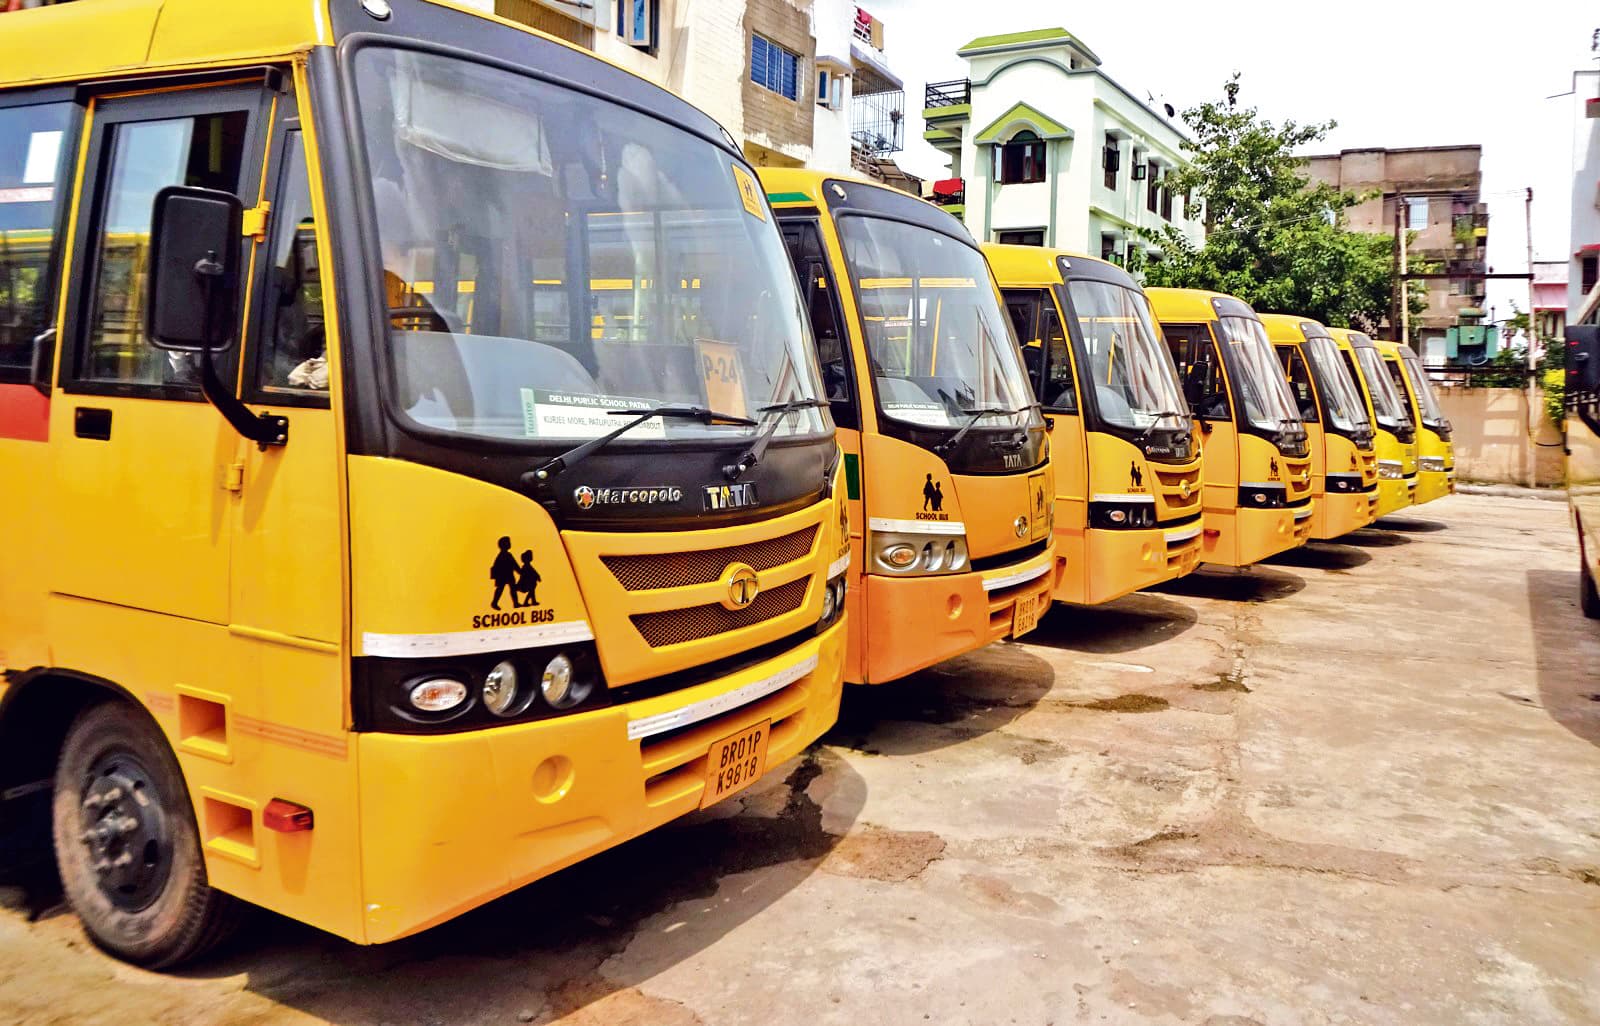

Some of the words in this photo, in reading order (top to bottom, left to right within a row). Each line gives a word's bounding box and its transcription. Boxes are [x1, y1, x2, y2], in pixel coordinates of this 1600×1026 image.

[703, 355, 738, 384] P-24
[549, 395, 572, 403] DELHI
[573, 397, 599, 406] PUBLIC
[600, 398, 628, 408] SCHOOL
[629, 401, 651, 409] PATNA
[1003, 453, 1023, 469] TATA
[596, 487, 682, 504] Marcopolo
[706, 483, 760, 511] TATA
[915, 512, 938, 521] SCHOOL
[472, 612, 527, 629] SCHOOL
[531, 609, 555, 623] BUS
[720, 730, 762, 769] BR01P
[716, 756, 758, 796] K9818
